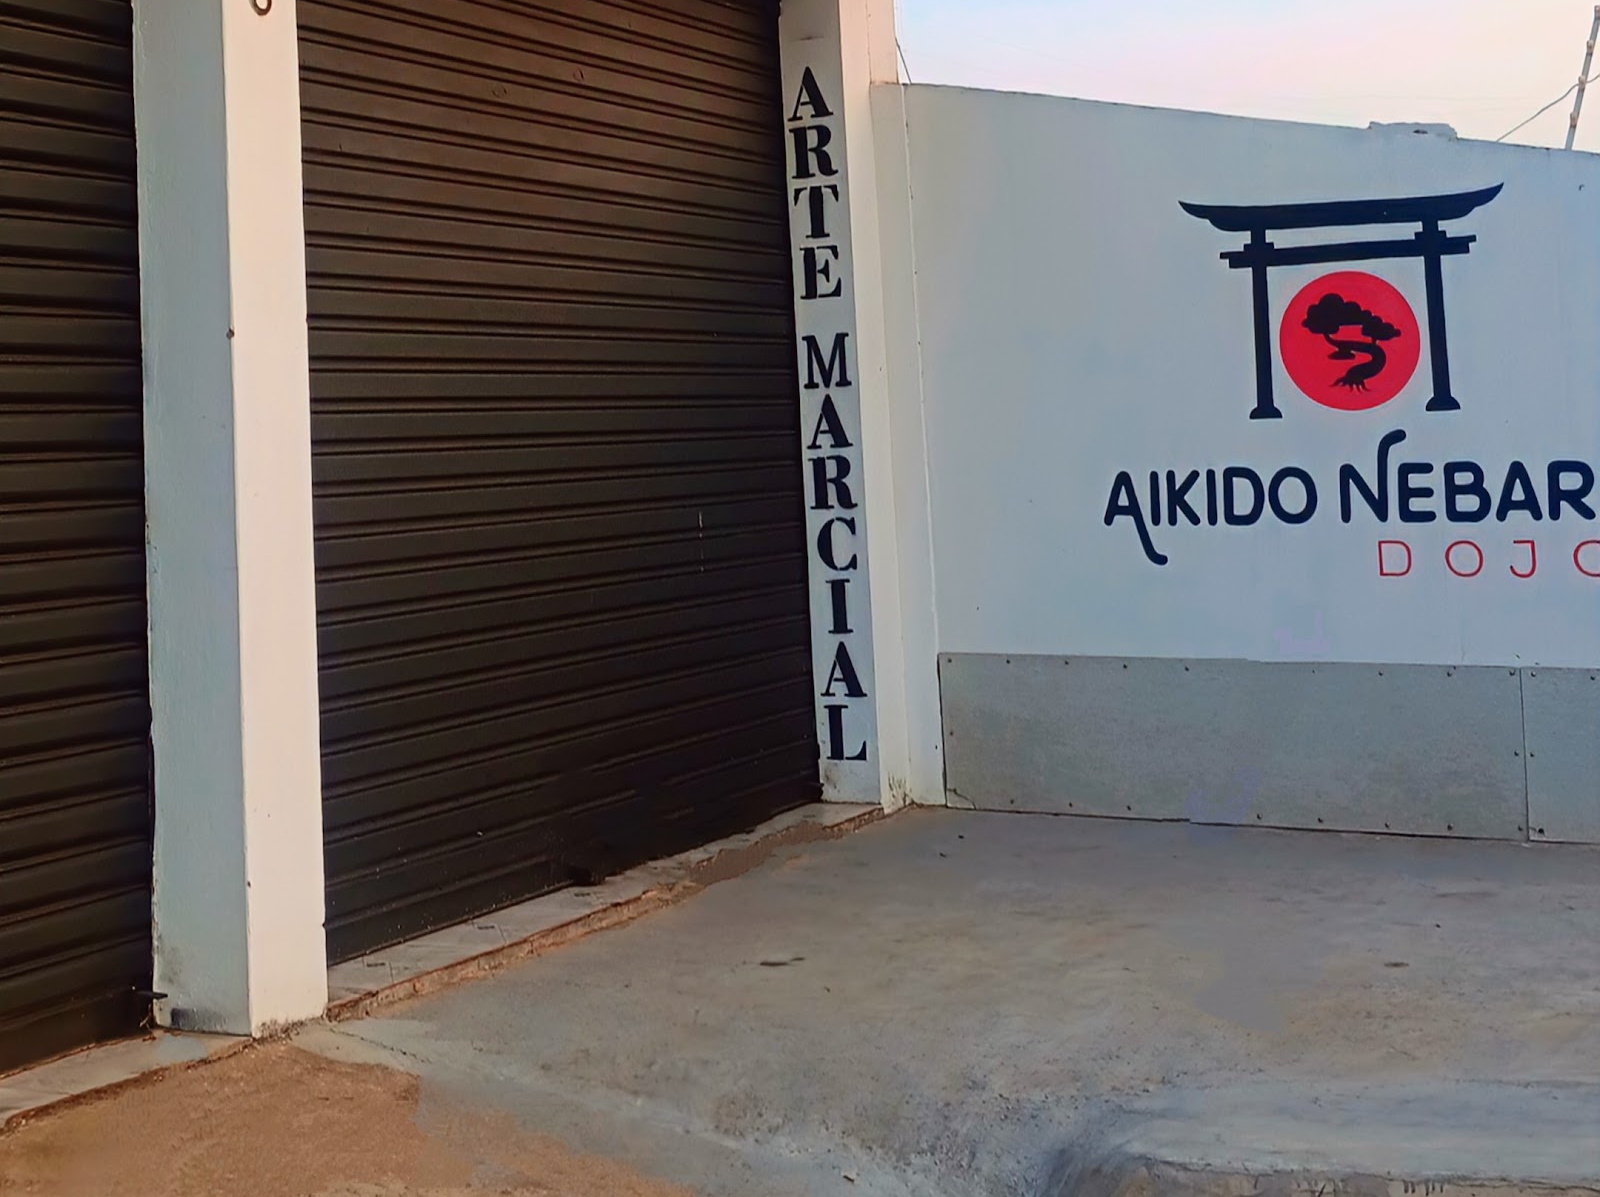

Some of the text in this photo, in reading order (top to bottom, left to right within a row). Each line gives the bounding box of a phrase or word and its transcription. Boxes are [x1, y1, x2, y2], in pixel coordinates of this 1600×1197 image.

[787, 66, 868, 761] ARTE MARCIAL
[1103, 466, 1318, 566] AIKIDO
